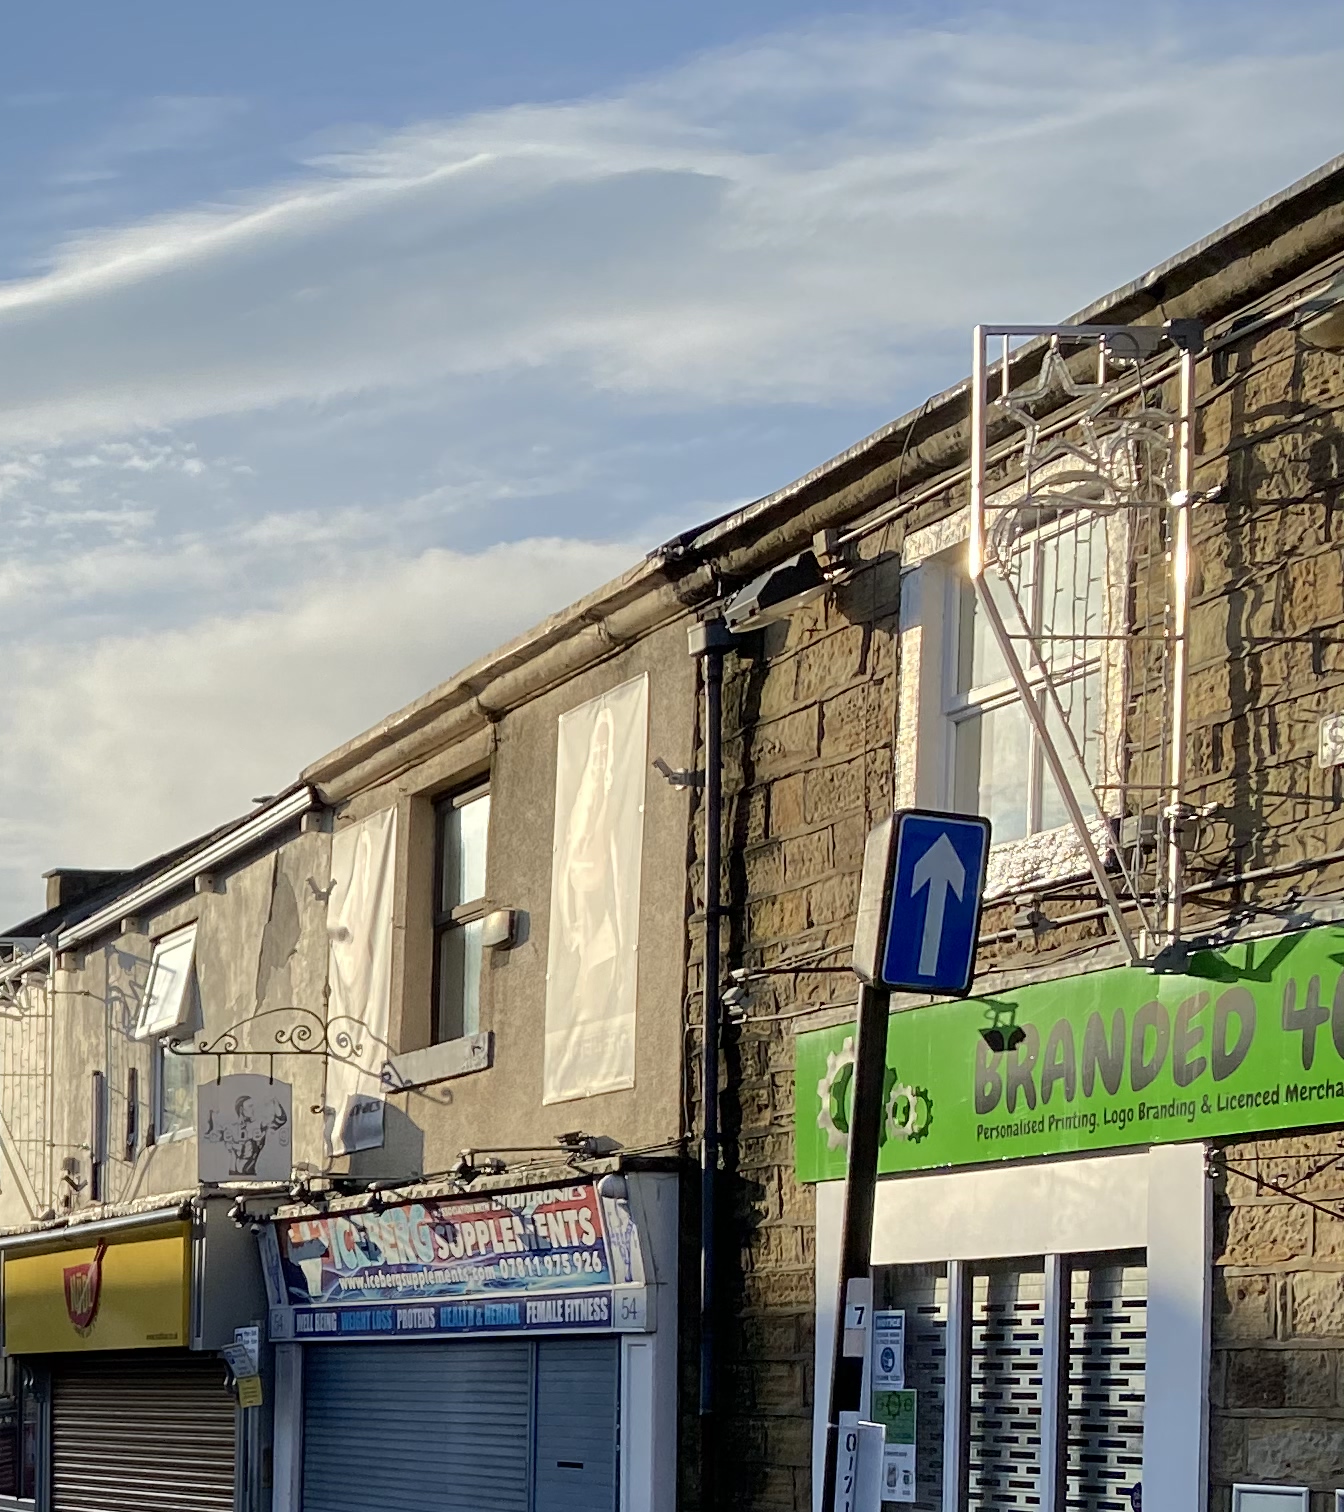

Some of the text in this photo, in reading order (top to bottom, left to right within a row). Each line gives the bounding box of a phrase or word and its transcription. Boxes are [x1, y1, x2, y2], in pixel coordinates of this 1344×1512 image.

[974, 986, 1257, 1115] BRANDED
[976, 1117, 1045, 1142] Personalised
[1103, 1106, 1135, 1130] Logo
[1138, 1099, 1196, 1123] Branding
[1200, 1094, 1213, 1113] &
[1216, 1085, 1281, 1112] Licenced
[326, 1203, 435, 1270] ICEBERG
[338, 1264, 496, 1292] www.icebergsupplements.com
[296, 1296, 609, 1333] WELL BEING WEIGHT LOSS PROTEINS HEALTH & HERBAL FEMALE FITNESS
[620, 1297, 638, 1320] 54
[854, 1306, 865, 1325] 7
